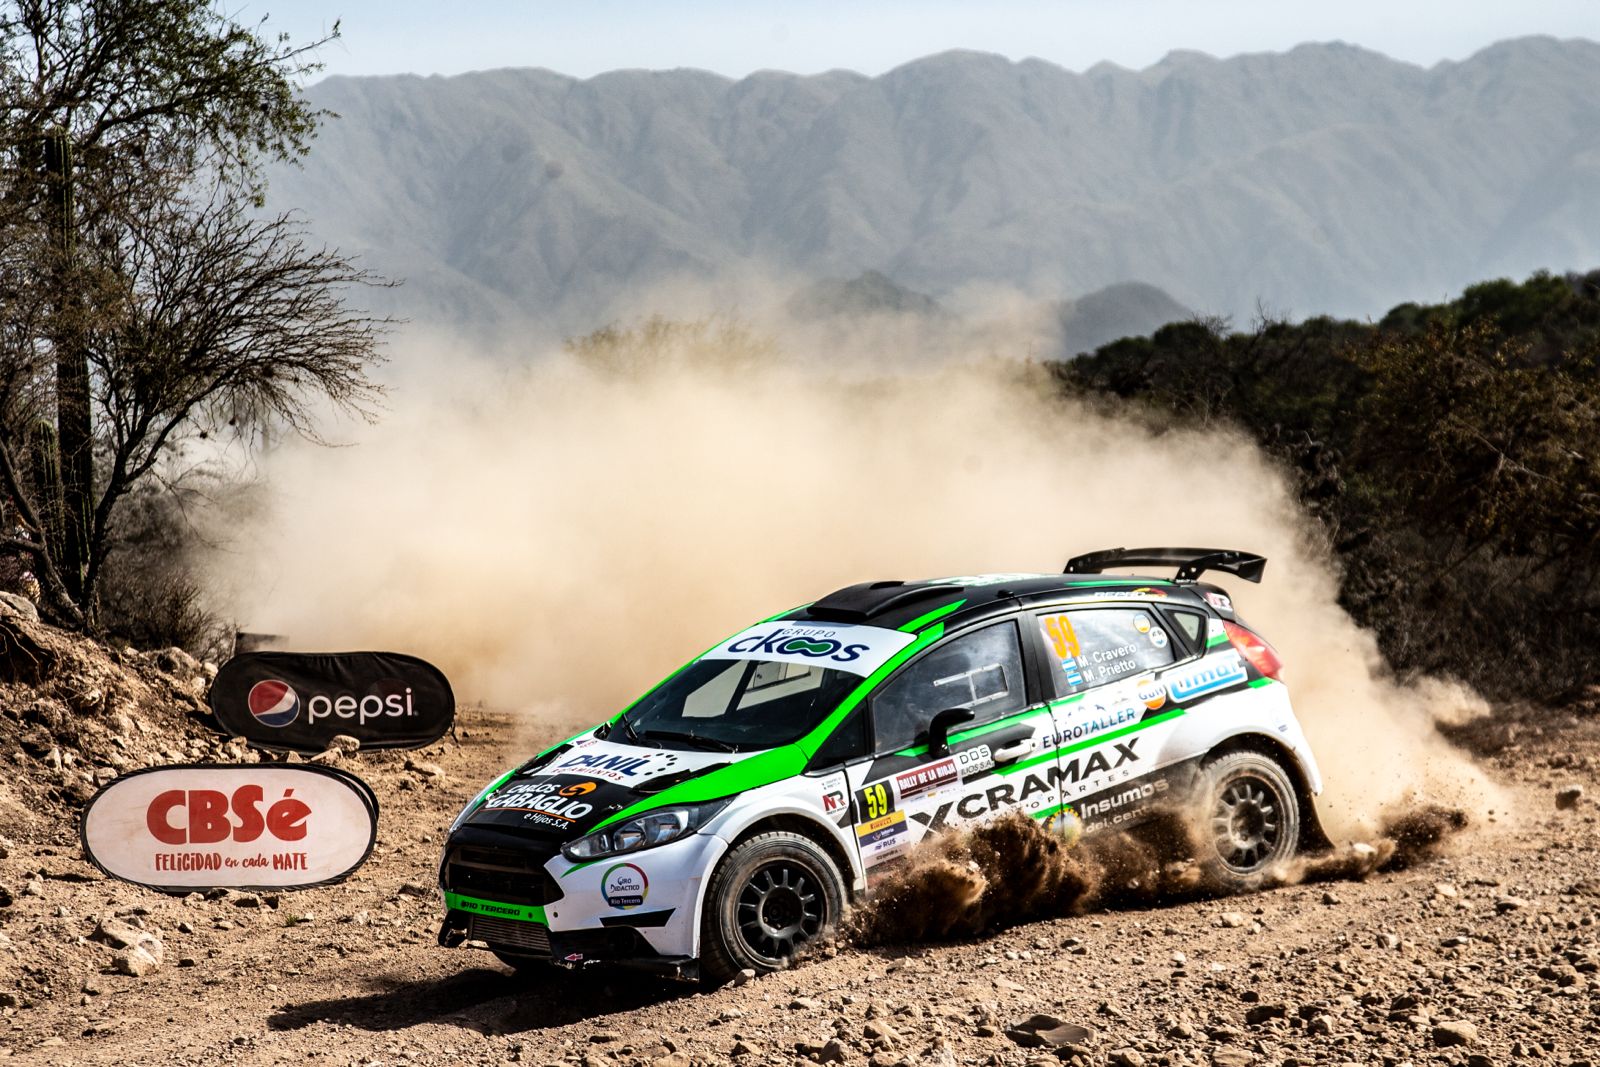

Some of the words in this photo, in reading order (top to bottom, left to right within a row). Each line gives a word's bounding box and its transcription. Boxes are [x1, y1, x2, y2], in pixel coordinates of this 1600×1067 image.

[782, 628, 836, 638] GRUPO
[1044, 615, 1081, 659] 59
[1077, 656, 1093, 668] M.
[1092, 643, 1137, 663] Cravero
[1083, 671, 1098, 682] M.
[1099, 659, 1136, 677] Prietto
[308, 687, 413, 725] pepsi
[1043, 707, 1136, 749] EUROTALLER
[558, 754, 652, 777] DANIL
[507, 782, 562, 794] CARLOS
[899, 777, 918, 791] RALLY
[918, 773, 929, 785] DE
[928, 769, 937, 781] LA
[484, 792, 594, 819] GABAGLIO
[863, 783, 888, 819] 59
[1081, 778, 1170, 820] Insumos
[146, 784, 313, 846] CBSé
[531, 813, 550, 825] Hijos
[551, 819, 569, 830] S.A.
[883, 838, 897, 848] RUS
[225, 857, 239, 868] en
[242, 853, 269, 868] cada
[273, 853, 309, 871] MATE
[481, 904, 520, 916] TERCERO
